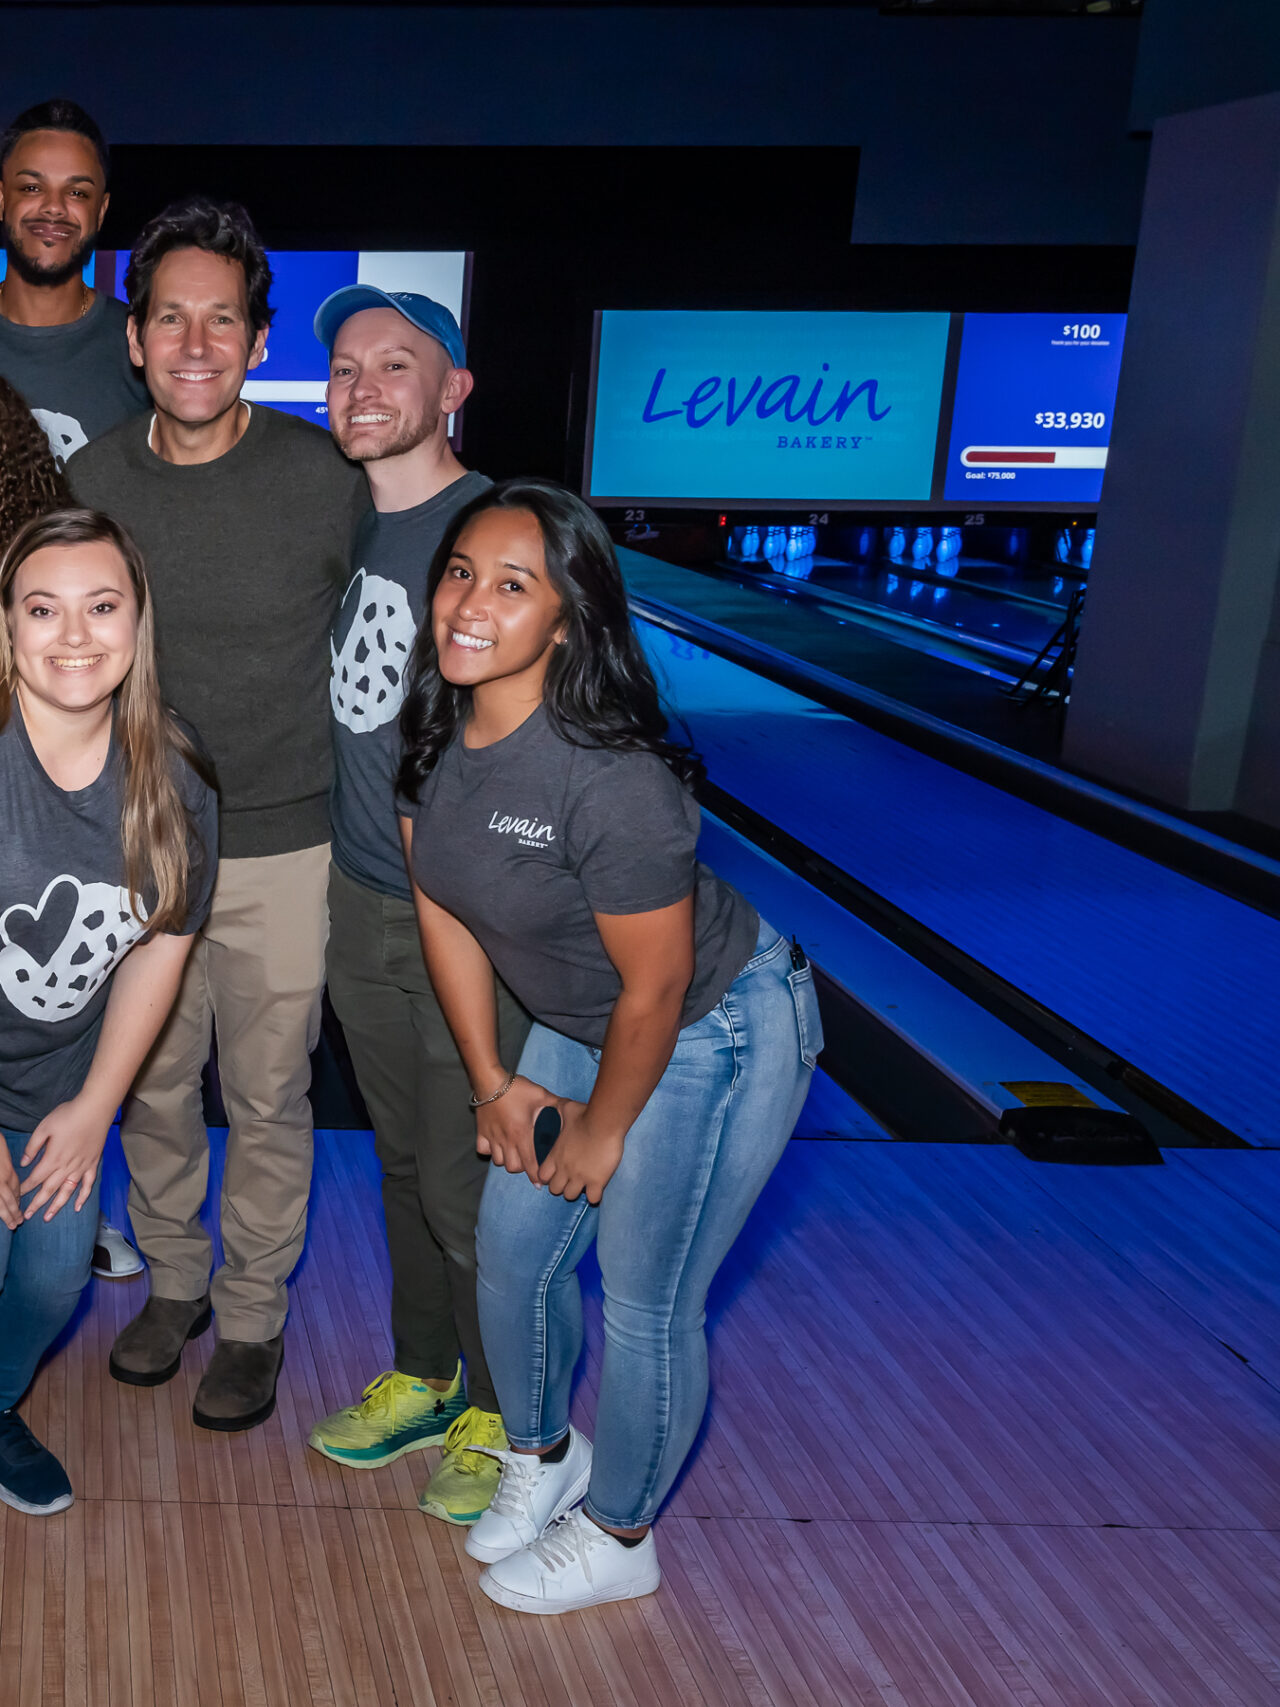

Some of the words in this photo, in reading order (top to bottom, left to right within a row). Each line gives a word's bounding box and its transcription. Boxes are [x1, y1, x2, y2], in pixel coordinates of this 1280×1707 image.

[1063, 324, 1101, 339] $100
[642, 362, 892, 429] Levain
[1035, 412, 1106, 430] $33,930
[965, 472, 986, 480] Goal:
[987, 472, 1016, 480] $75,000
[624, 509, 645, 521] 23
[809, 513, 829, 525] 24
[964, 513, 985, 525] 25
[488, 810, 556, 841] Levain
